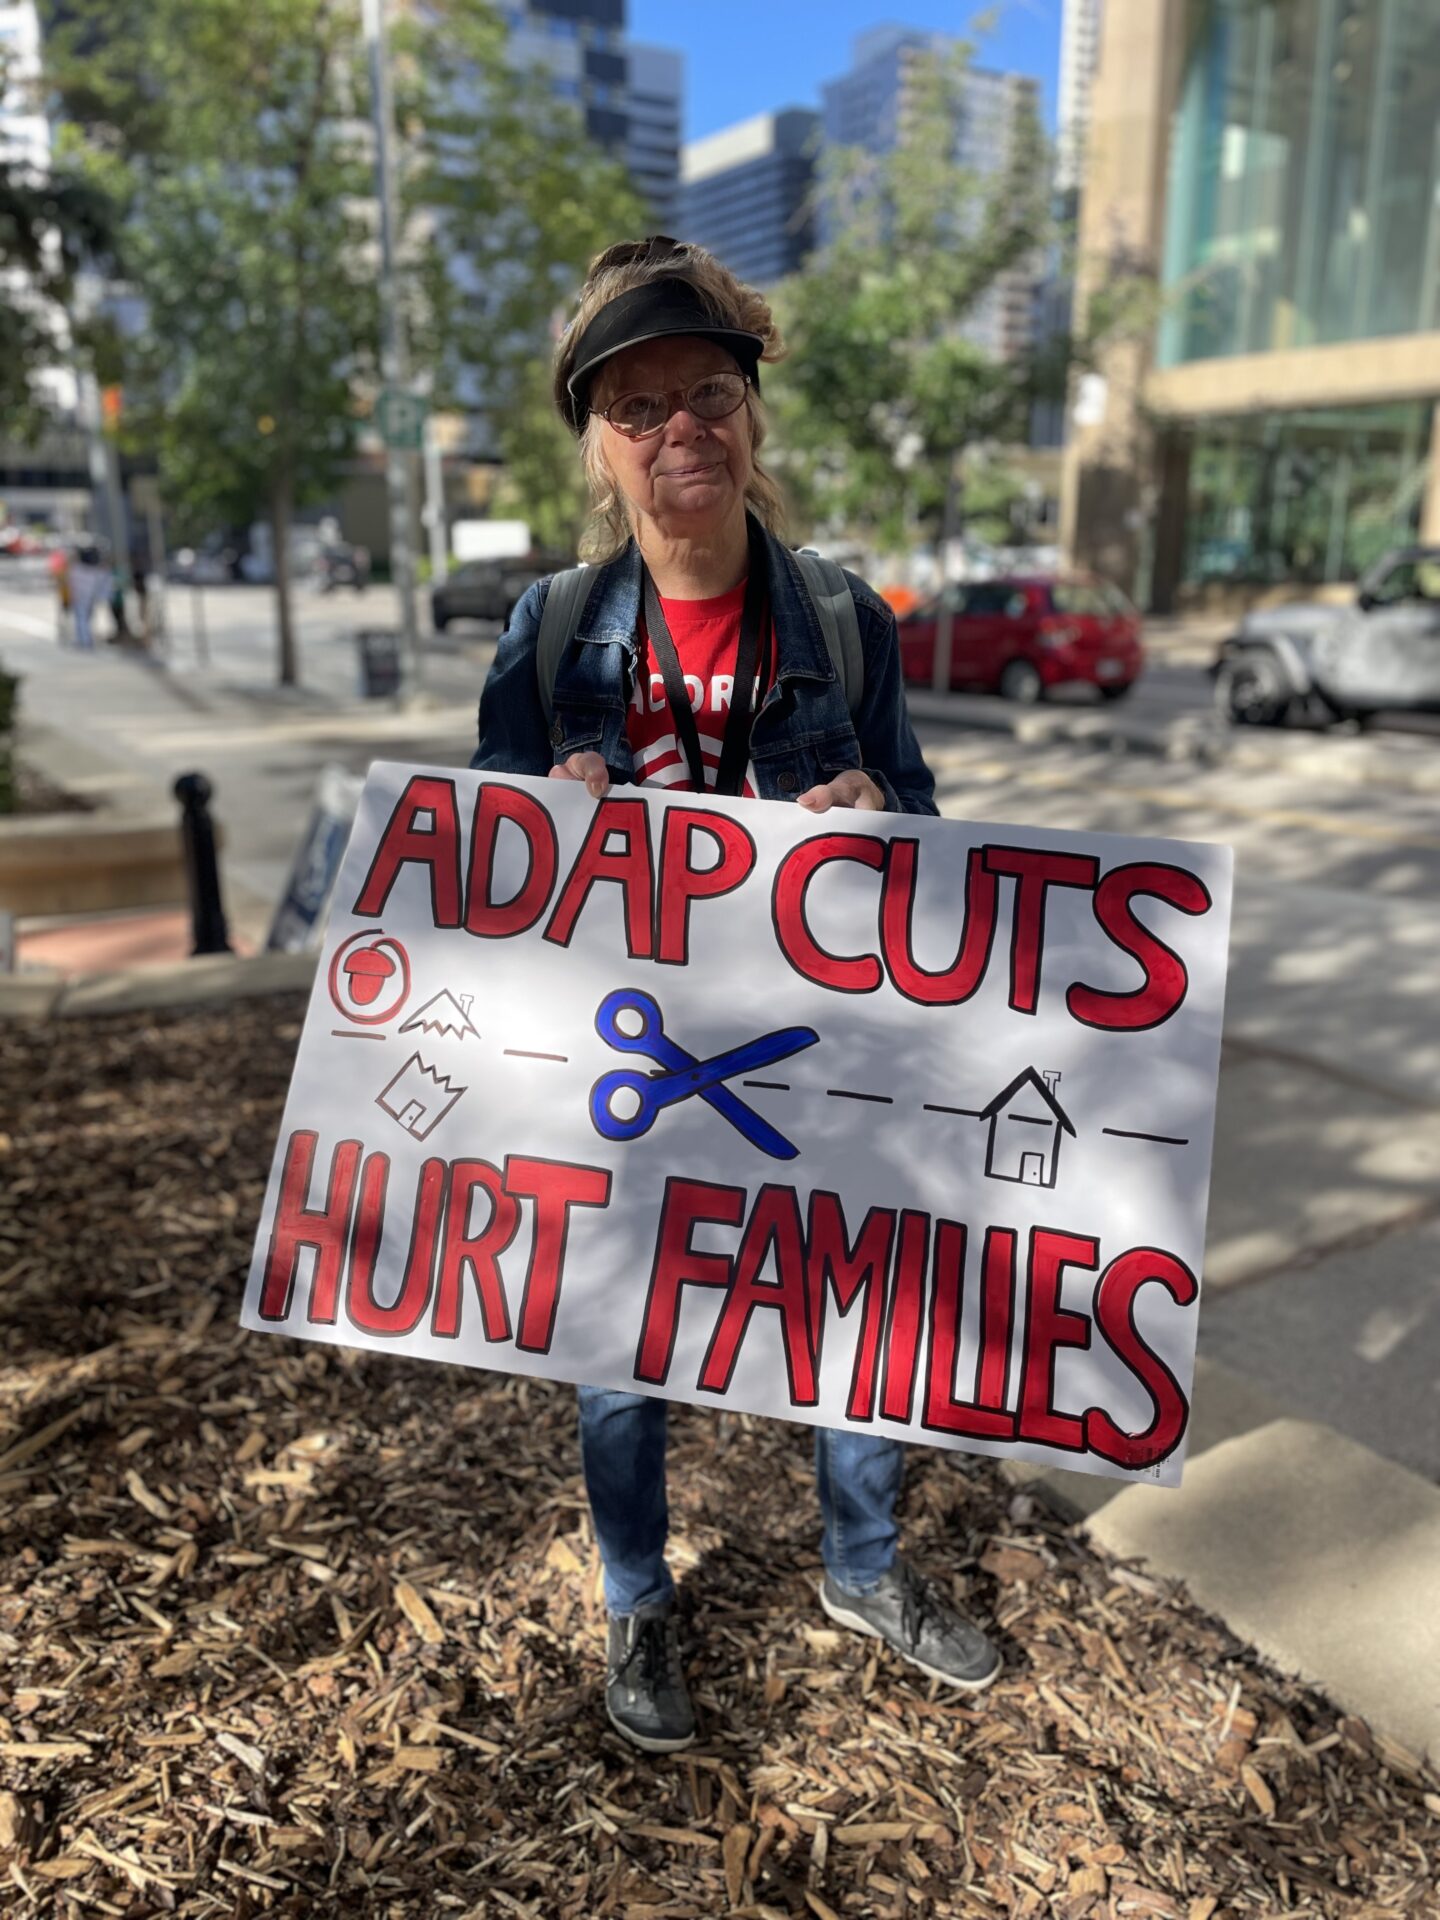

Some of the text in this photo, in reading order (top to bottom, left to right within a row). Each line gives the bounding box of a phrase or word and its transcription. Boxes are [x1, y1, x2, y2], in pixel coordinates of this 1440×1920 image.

[352, 775, 757, 966] ADAP
[771, 832, 1212, 1032] CUTS
[258, 1129, 1198, 1470] HURT FAMILIES
